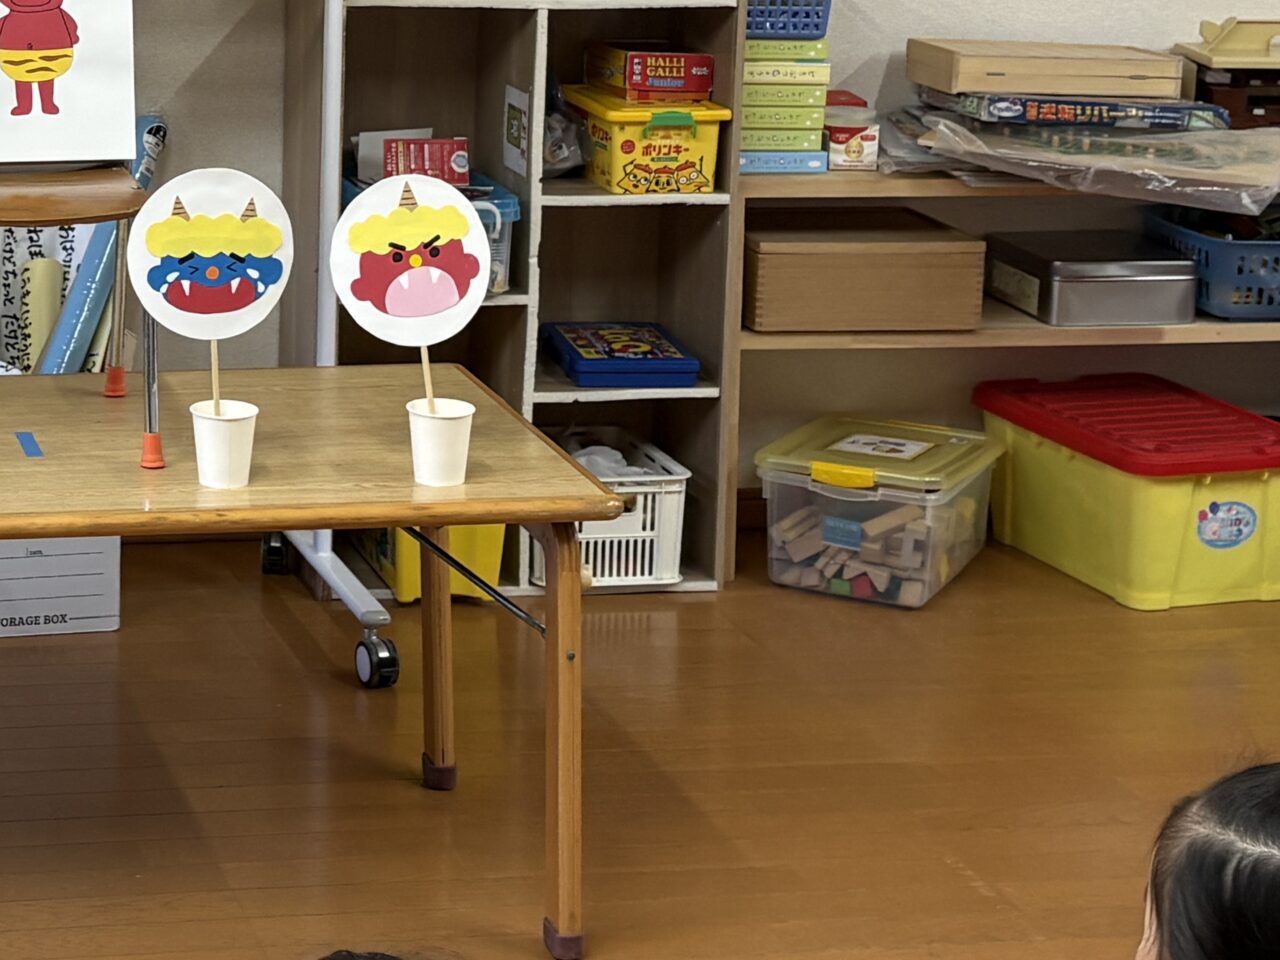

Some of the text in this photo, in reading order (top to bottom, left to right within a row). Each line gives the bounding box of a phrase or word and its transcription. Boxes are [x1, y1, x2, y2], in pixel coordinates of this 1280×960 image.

[646, 56, 685, 67] HALLI
[646, 66, 685, 77] GALLI
[646, 77, 685, 87] Junior
[642, 143, 690, 157] ポリンキー
[43, 614, 69, 626] BOX
